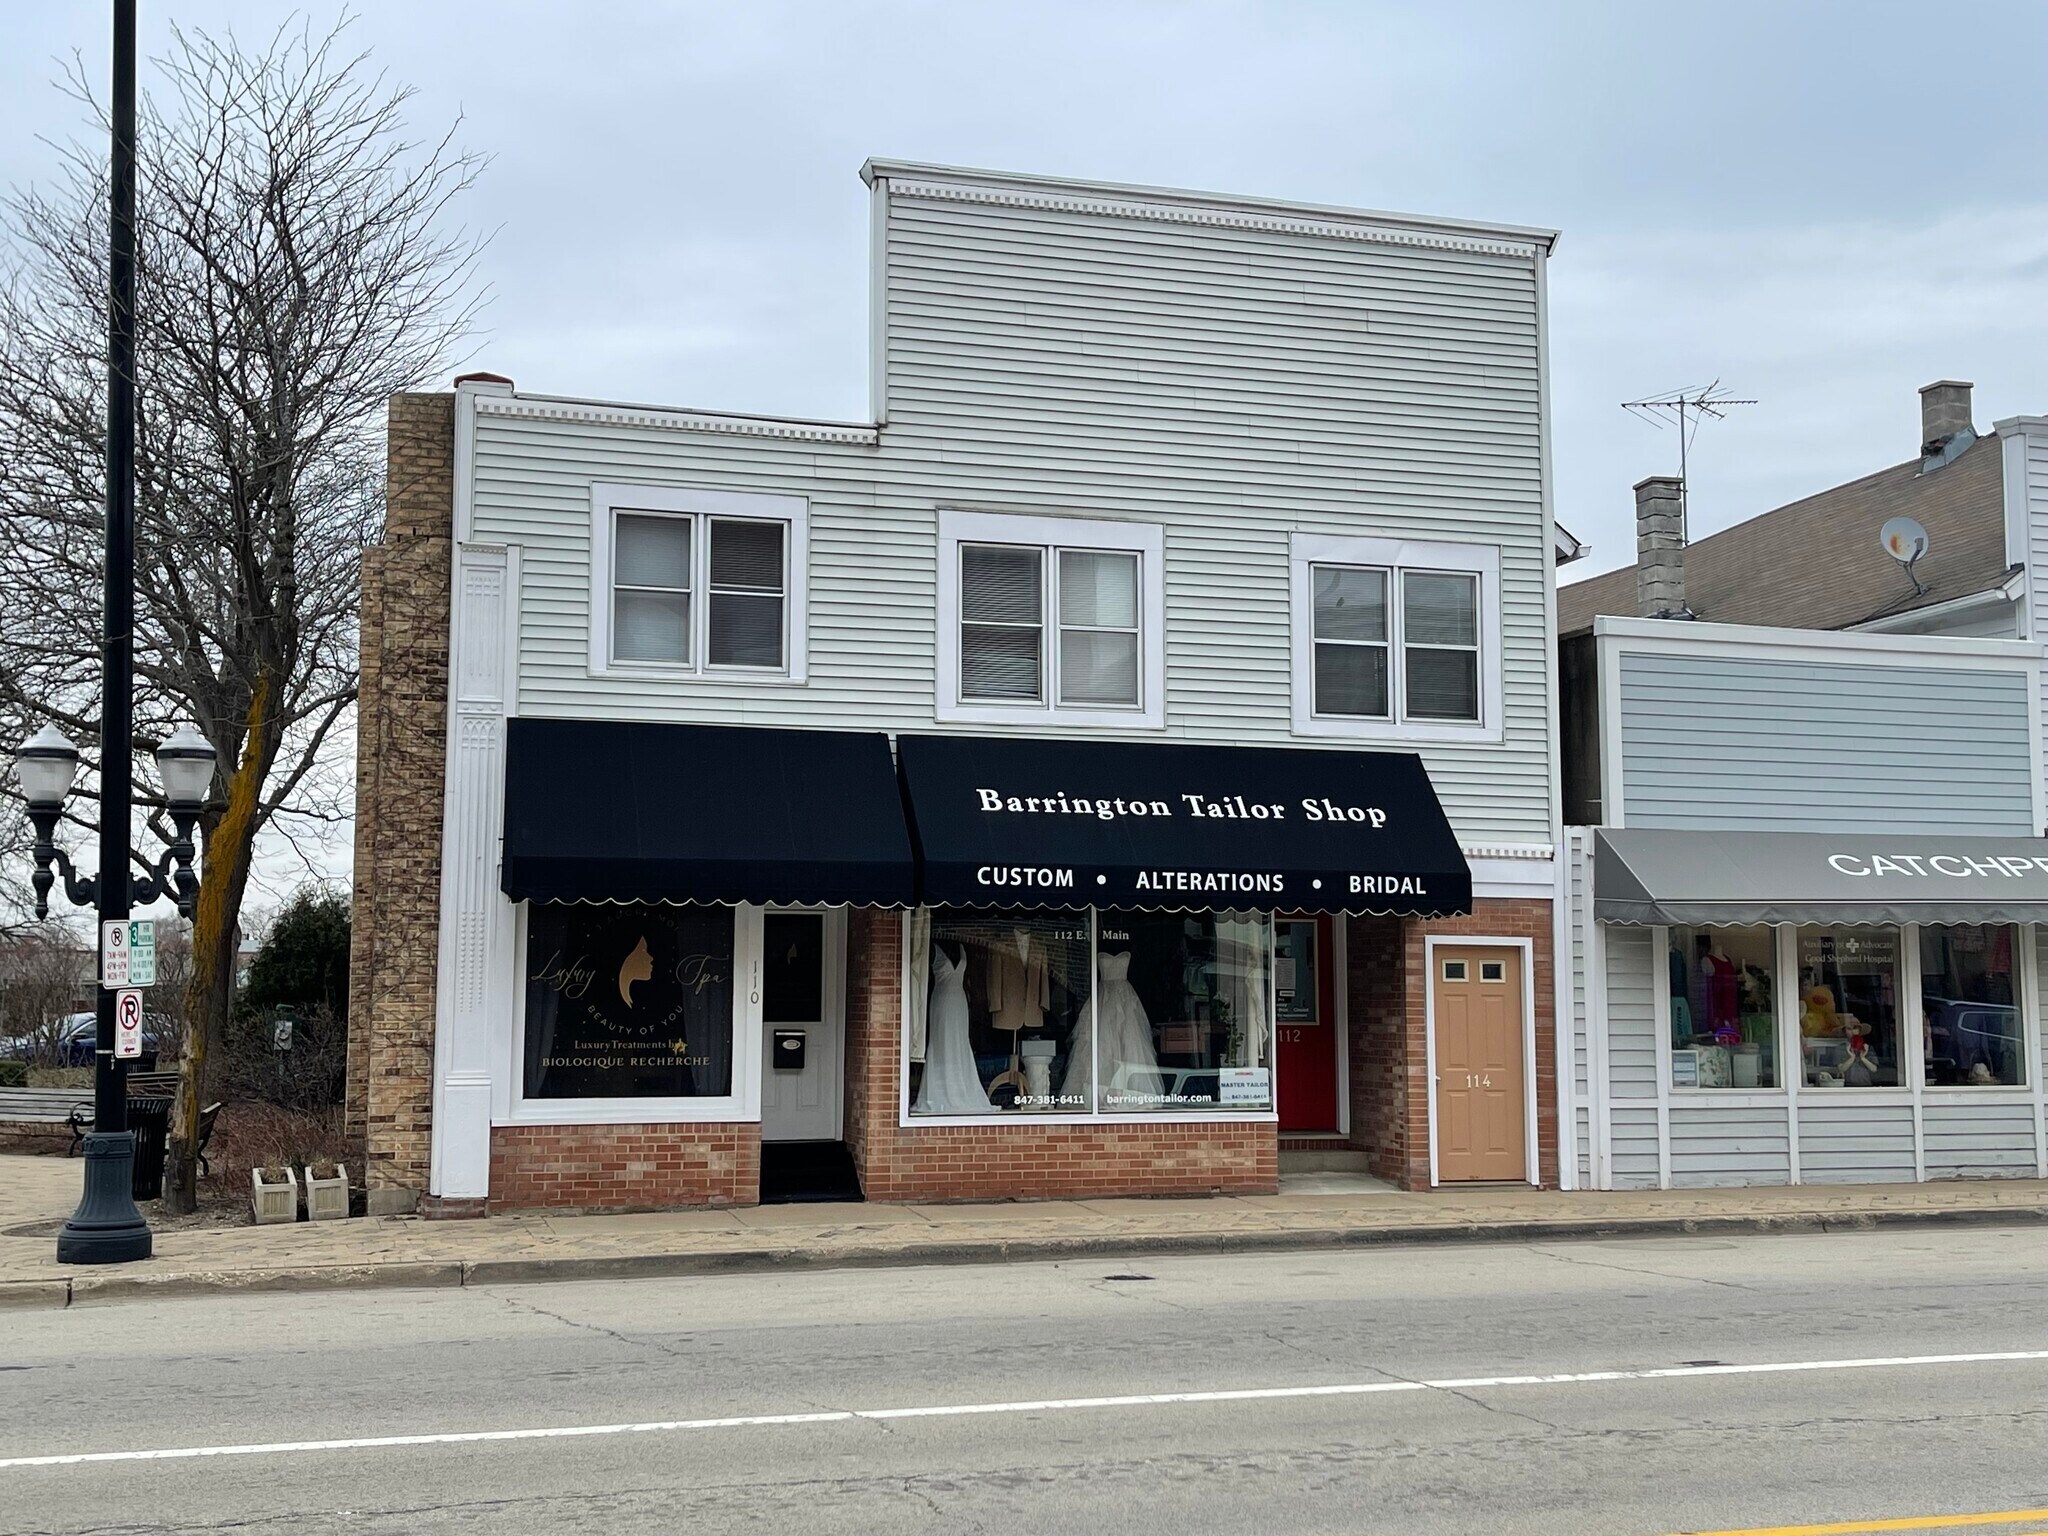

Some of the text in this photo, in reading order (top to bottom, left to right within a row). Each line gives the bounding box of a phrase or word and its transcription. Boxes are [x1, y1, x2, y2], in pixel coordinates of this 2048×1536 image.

[976, 787, 1388, 828] Barrington Tailor Shop
[976, 866, 1427, 896] CUSTOM ALTERATIONS BRIDAL
[132, 926, 138, 943] 3
[1054, 929, 1130, 941] 112 E. Main
[1861, 940, 1894, 949] Advocate
[1804, 953, 1894, 964] Good Shepherd Hospital
[531, 948, 730, 999] Luxury Spa
[587, 1005, 684, 1035] BEAUTY OF YOU
[1279, 1029, 1302, 1043] 112
[574, 1040, 610, 1053] Luxury
[611, 1039, 666, 1049] Treatments
[542, 1056, 711, 1070] BIOLOGIQUE RECHERCHE
[1466, 1074, 1492, 1089] 114
[1014, 1094, 1085, 1106] 847-381-6411
[1106, 1093, 1212, 1107] barringtontailor.com
